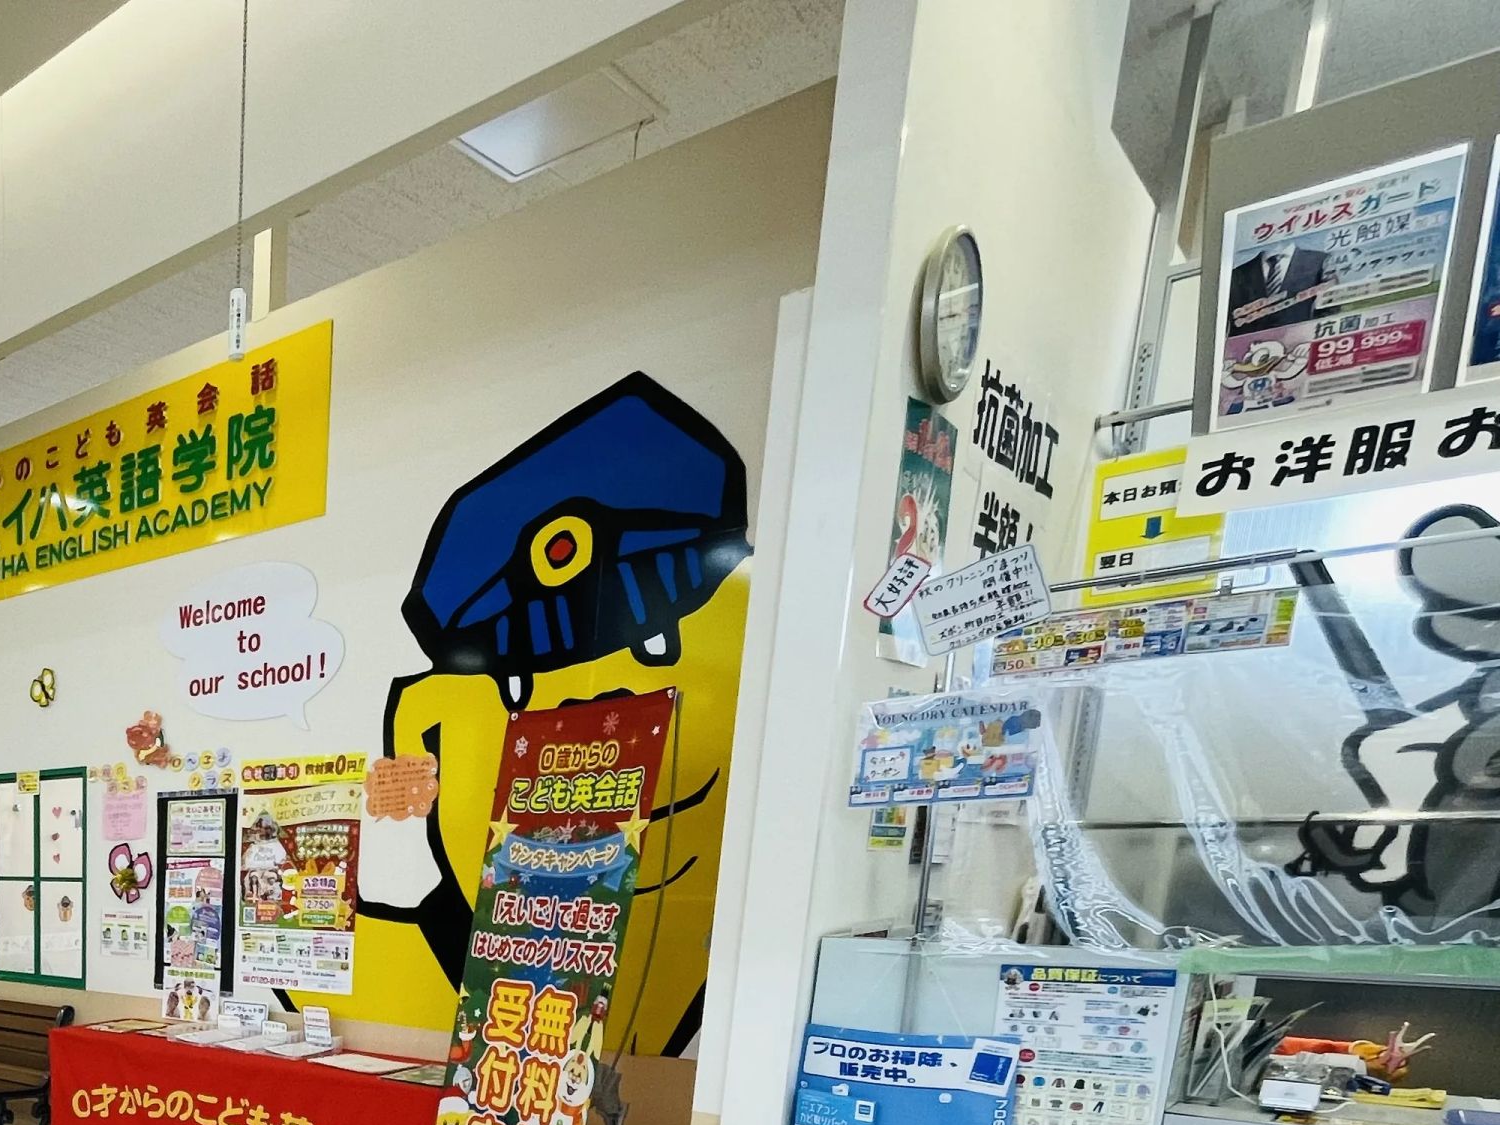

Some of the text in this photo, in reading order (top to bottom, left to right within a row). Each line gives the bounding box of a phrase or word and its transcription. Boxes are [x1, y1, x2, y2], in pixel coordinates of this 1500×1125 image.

[1254, 178, 1441, 240] ウイルスガード
[973, 359, 1060, 499] 抗菌加工
[1103, 479, 1182, 505] 本日お預
[35, 519, 129, 570] ENGLISH
[135, 477, 274, 543] ACADEMY
[1099, 552, 1134, 570] 翌日
[179, 592, 267, 630] Welcome
[238, 629, 261, 654] to
[189, 653, 327, 698] our school!
[921, 708, 945, 720] DRY
[539, 740, 620, 772] 0歳からの
[510, 767, 644, 812] こども英会話
[509, 842, 620, 872] サンタキャンペーン
[492, 891, 620, 931] 「えいご」で過ごす
[471, 931, 616, 977] はじめてのクリスマス
[1031, 968, 1142, 984] 品質保証について
[840, 1062, 915, 1083] 販売中。
